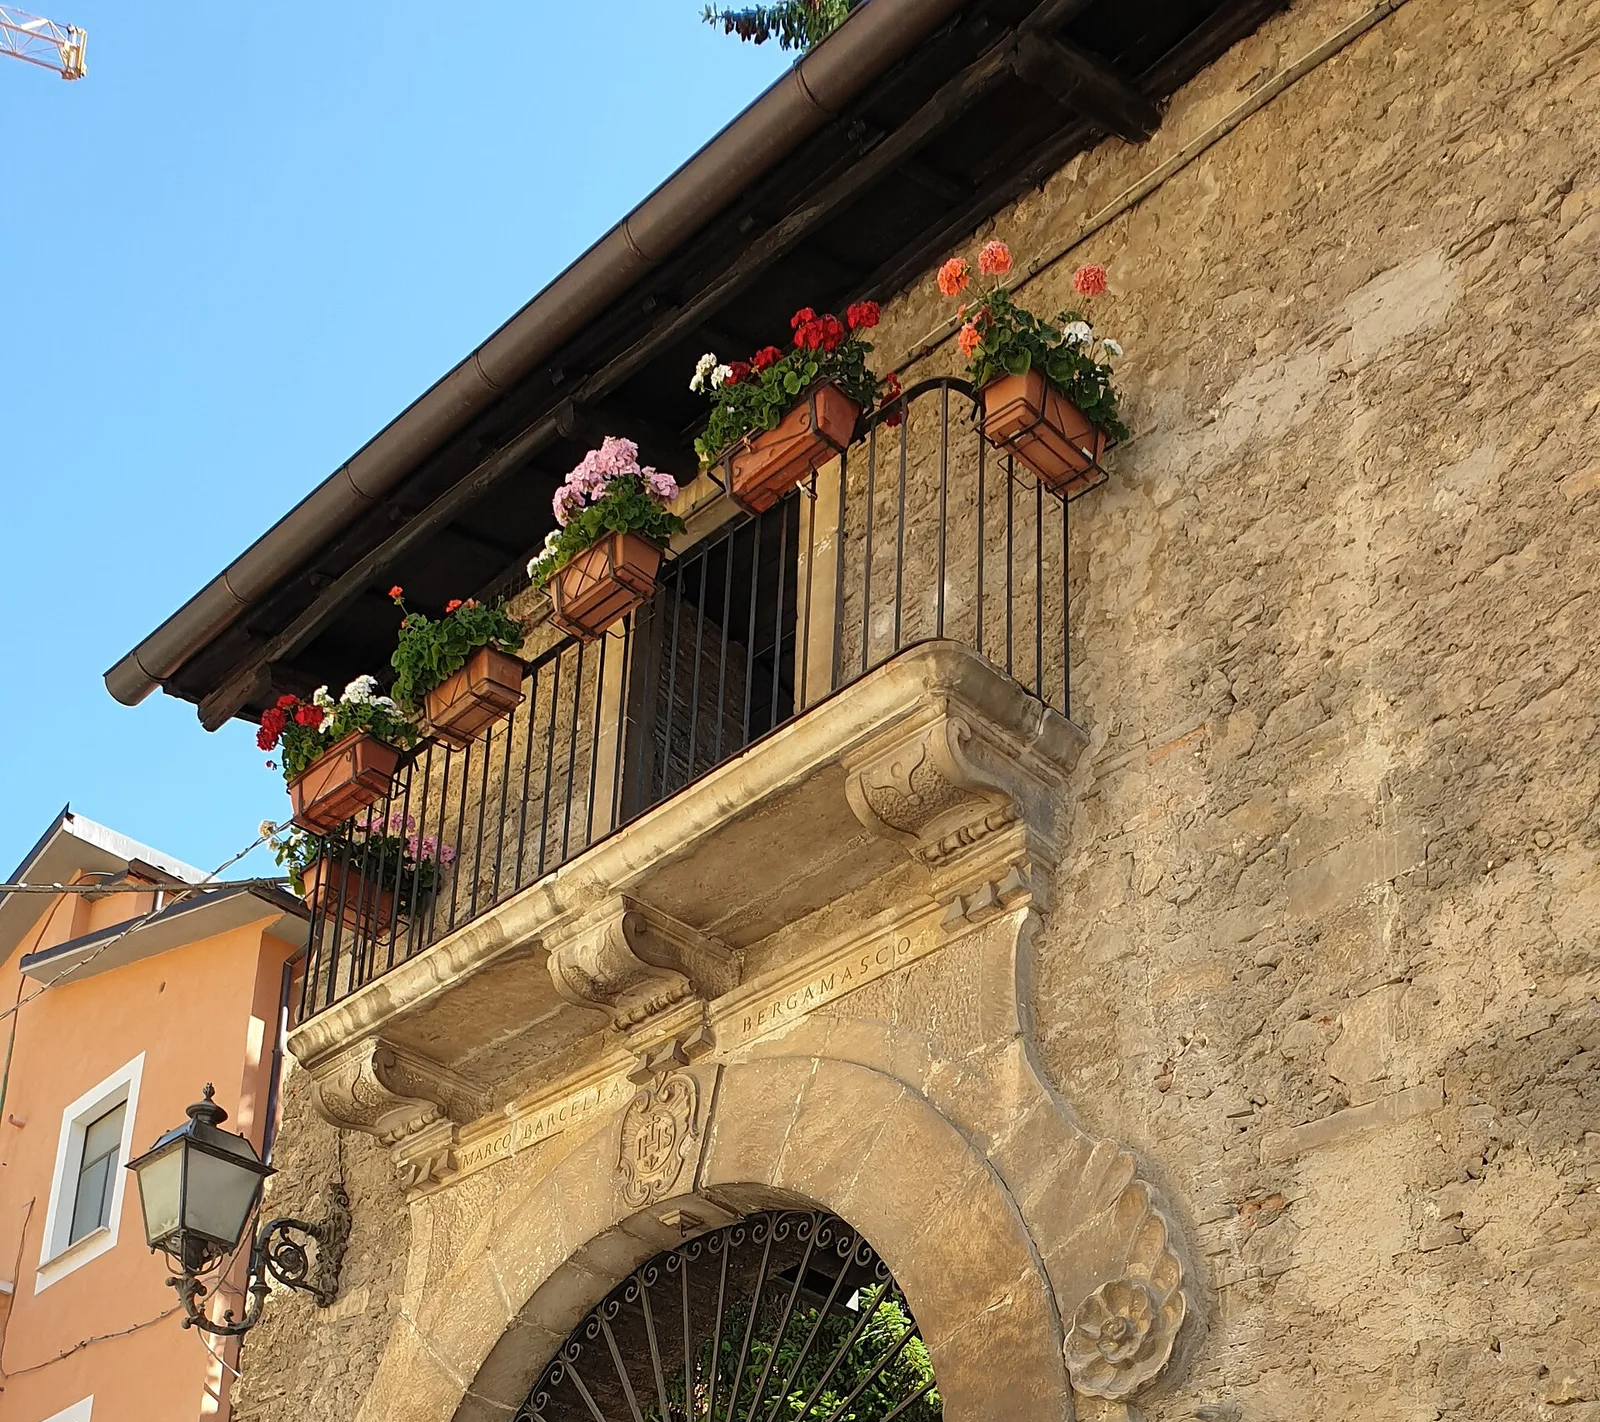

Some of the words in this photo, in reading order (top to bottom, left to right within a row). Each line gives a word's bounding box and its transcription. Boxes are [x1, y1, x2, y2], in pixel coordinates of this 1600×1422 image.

[462, 1133, 512, 1170] MARCO
[524, 1083, 620, 1140] BARCELLA
[742, 936, 911, 1033] BERGAMASCO
[635, 1116, 673, 1161] IHS
